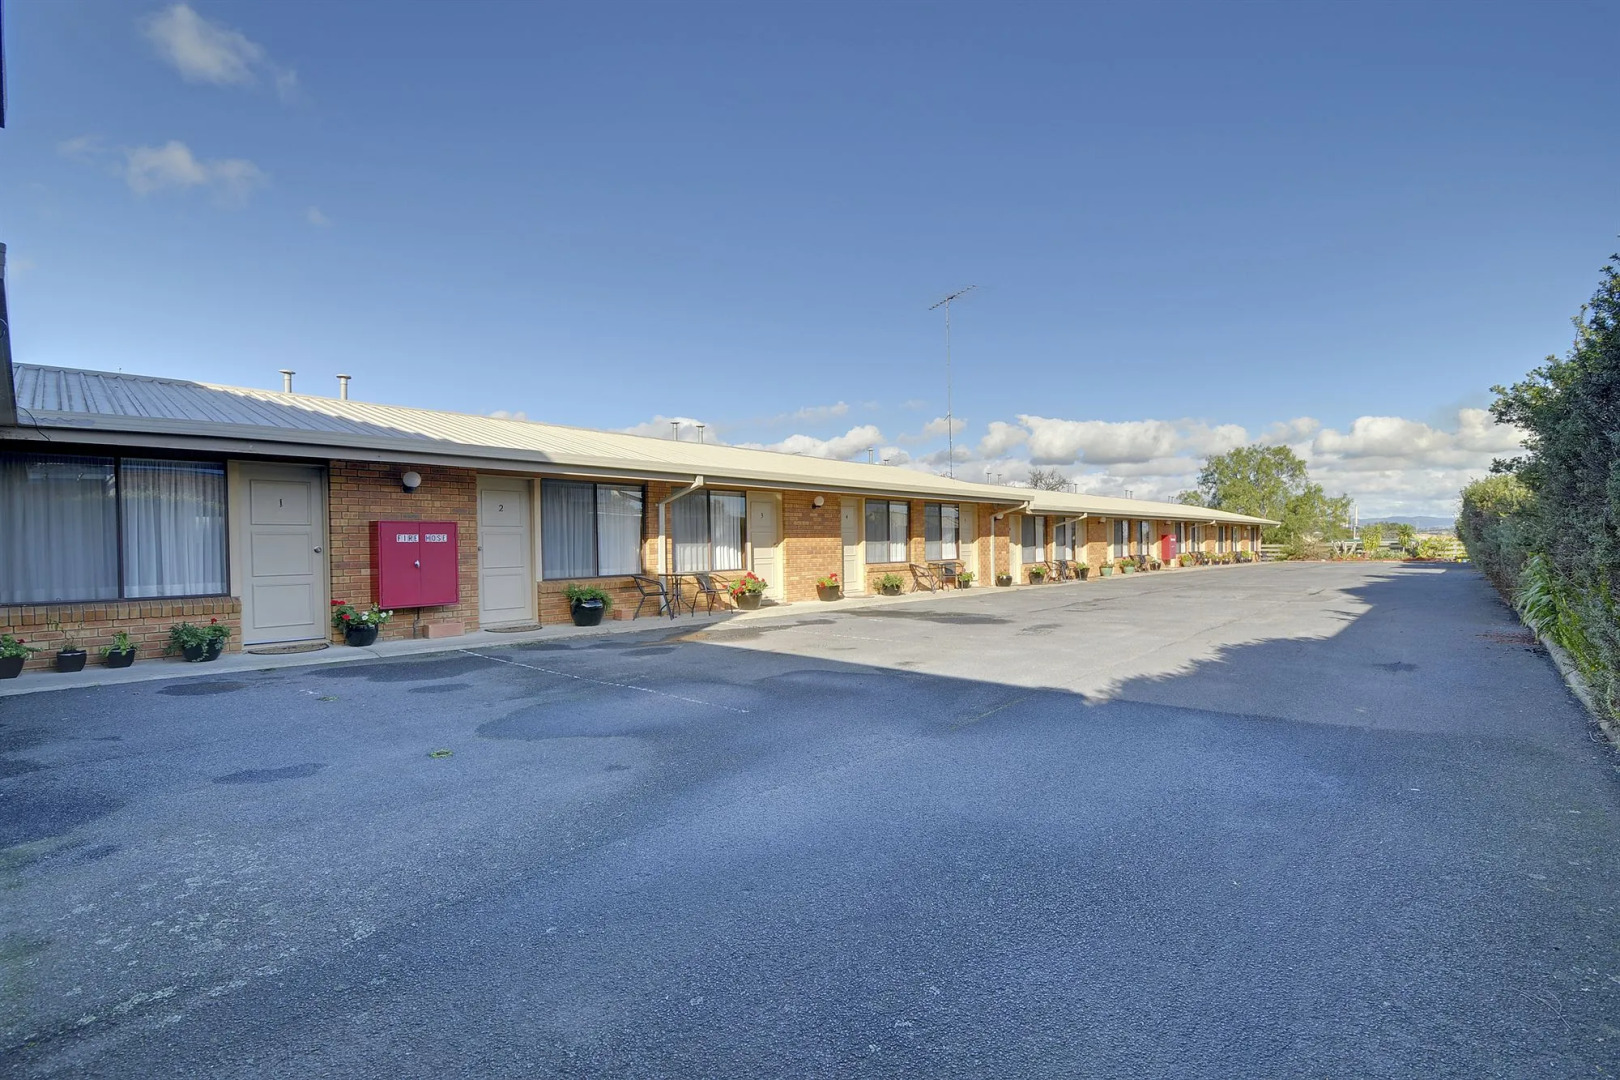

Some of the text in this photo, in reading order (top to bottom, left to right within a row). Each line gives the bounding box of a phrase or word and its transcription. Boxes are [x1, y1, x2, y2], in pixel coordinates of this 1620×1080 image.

[498, 504, 504, 512] 2
[397, 534, 446, 542] FIRE HOSE
